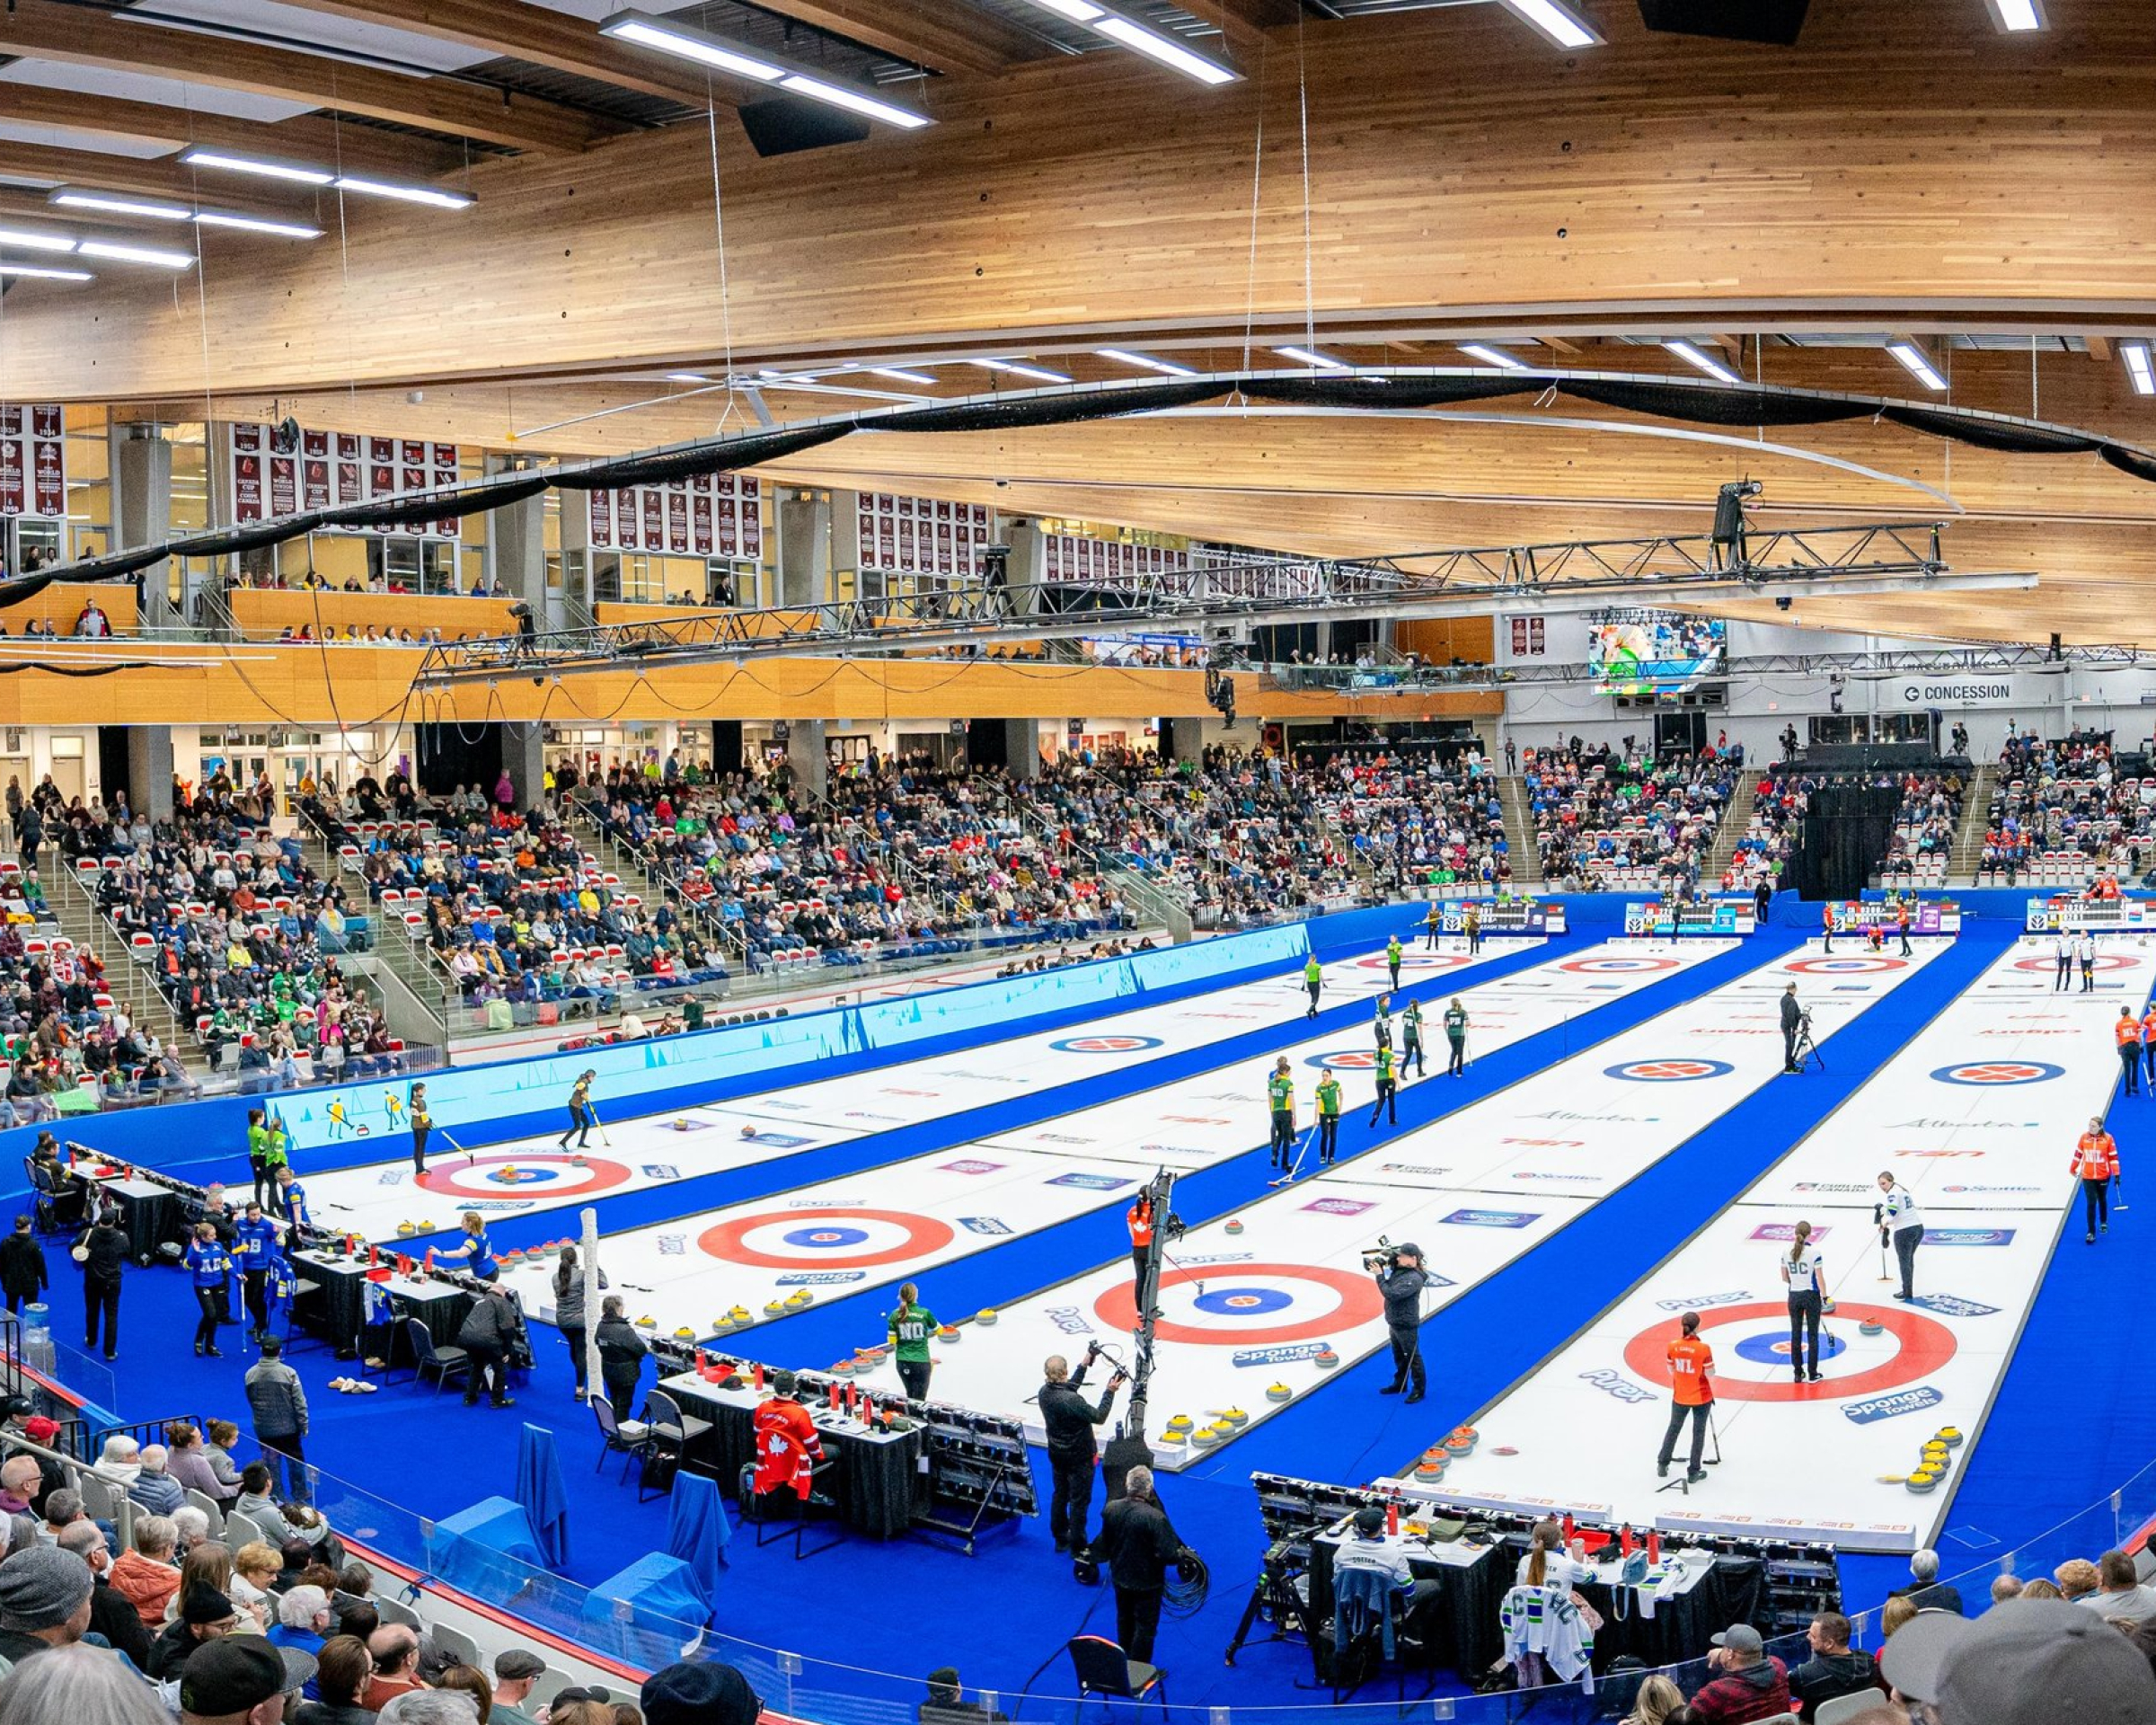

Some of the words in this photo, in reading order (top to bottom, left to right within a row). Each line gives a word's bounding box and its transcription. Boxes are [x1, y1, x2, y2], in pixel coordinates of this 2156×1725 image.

[1924, 685, 2010, 700] CONCESSION
[2122, 1028, 2135, 1037] NL
[1880, 1118, 2018, 1128] Alberta
[1499, 1137, 1586, 1147] TSN
[1895, 1149, 1986, 1157] TSN
[2084, 1149, 2105, 1163] NL
[1904, 1195, 1914, 1210] B
[1788, 1261, 1809, 1275] BC
[1656, 1290, 1754, 1311] Purex
[1045, 1305, 1094, 1335] Purex
[898, 1322, 924, 1340] NO
[1233, 1344, 1324, 1361] Sponge
[1265, 1352, 1317, 1363] Towel
[1674, 1358, 1695, 1374] NL
[1578, 1367, 1658, 1403] Purex
[1841, 1388, 1933, 1417] Sponge
[1879, 1397, 1939, 1415] Towels
